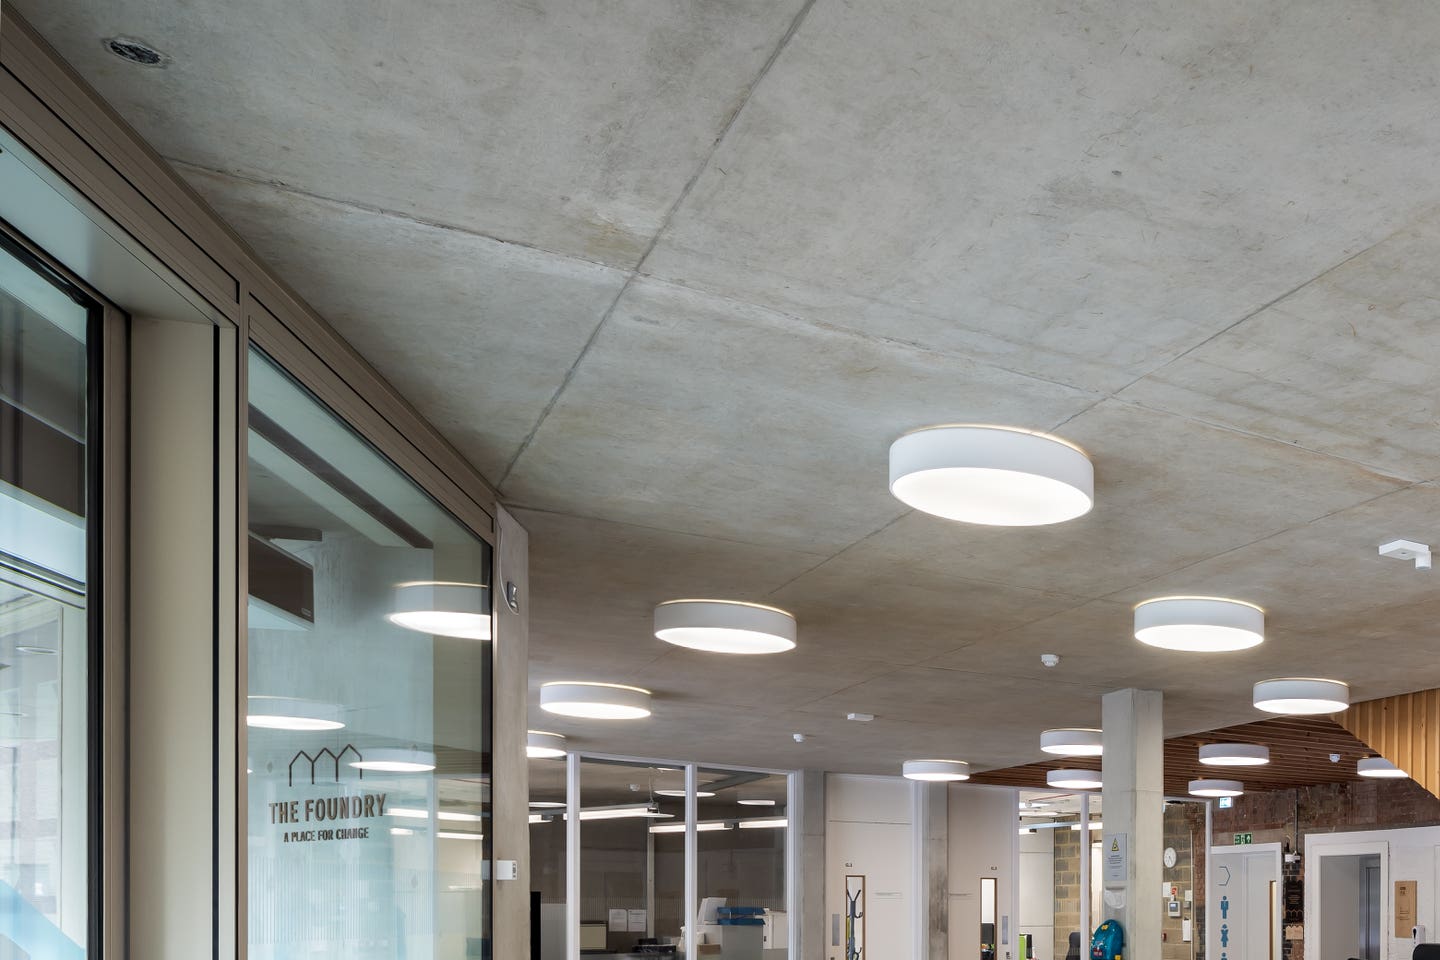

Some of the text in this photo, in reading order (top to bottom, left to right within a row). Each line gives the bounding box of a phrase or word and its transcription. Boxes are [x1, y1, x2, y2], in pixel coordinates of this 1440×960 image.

[269, 793, 387, 824] THE FOUNDRY
[284, 827, 369, 843] A PLACE FOR CHANGE
